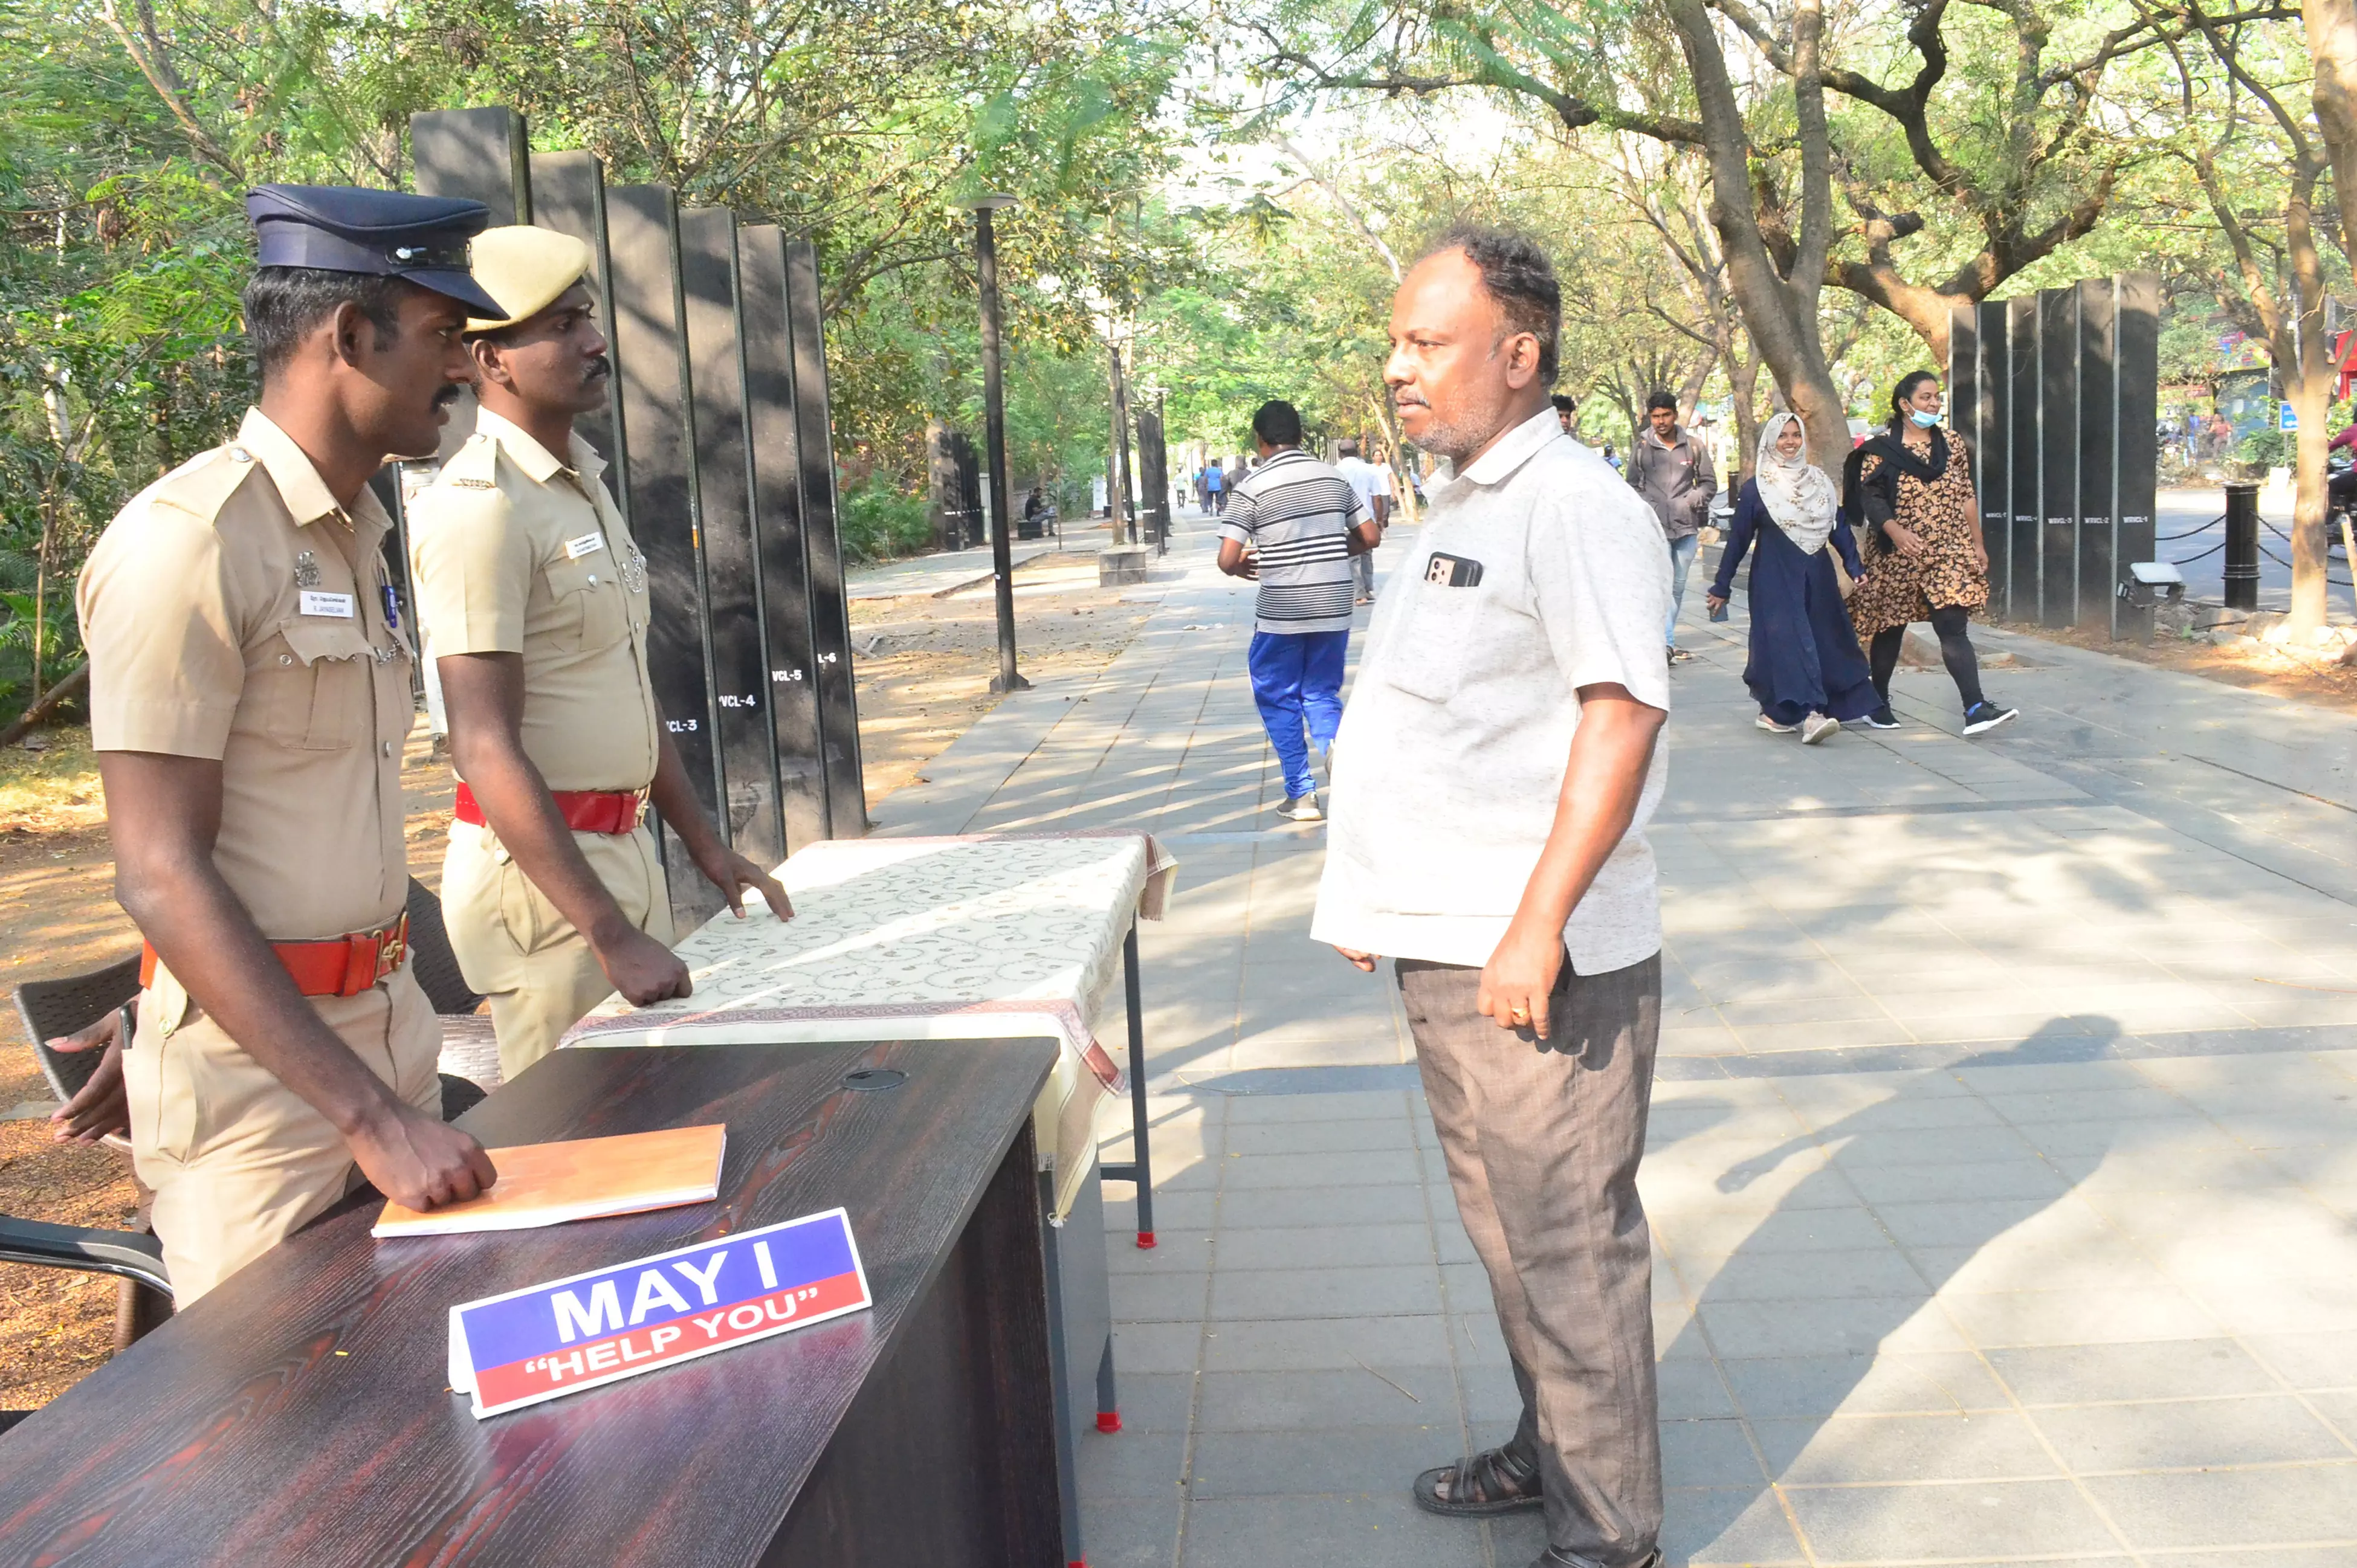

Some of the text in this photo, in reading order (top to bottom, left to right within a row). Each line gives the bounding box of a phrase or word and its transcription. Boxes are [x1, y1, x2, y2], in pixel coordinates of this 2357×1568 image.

[719, 694, 755, 707] VCL-4
[772, 669, 802, 682] VCL-5
[550, 1241, 778, 1343] MAY I
[525, 1287, 818, 1381] “HELP YOU”
